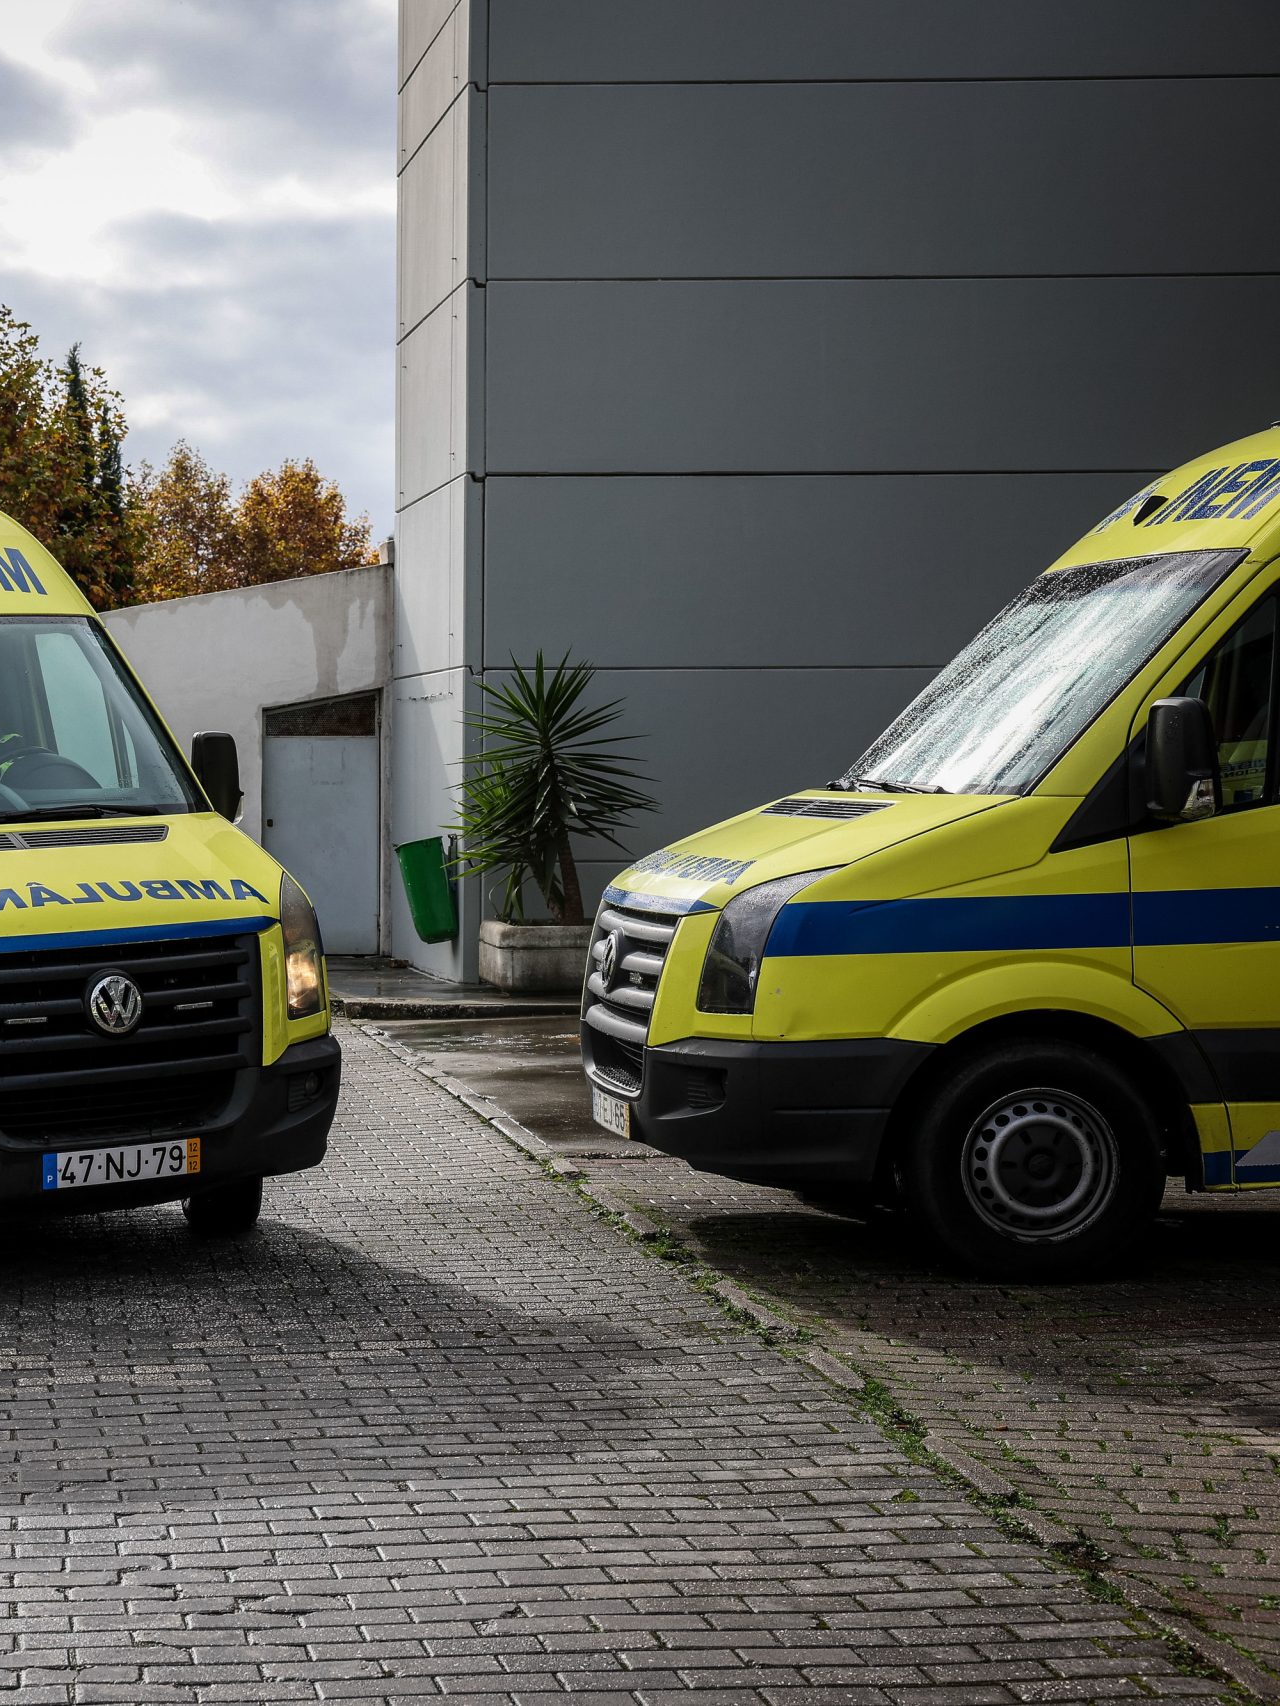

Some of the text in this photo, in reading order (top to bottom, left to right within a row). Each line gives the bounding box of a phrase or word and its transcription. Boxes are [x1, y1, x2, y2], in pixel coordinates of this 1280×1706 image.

[189, 1142, 198, 1152] 12
[189, 1161, 198, 1171] 12
[47, 1175, 53, 1184] P
